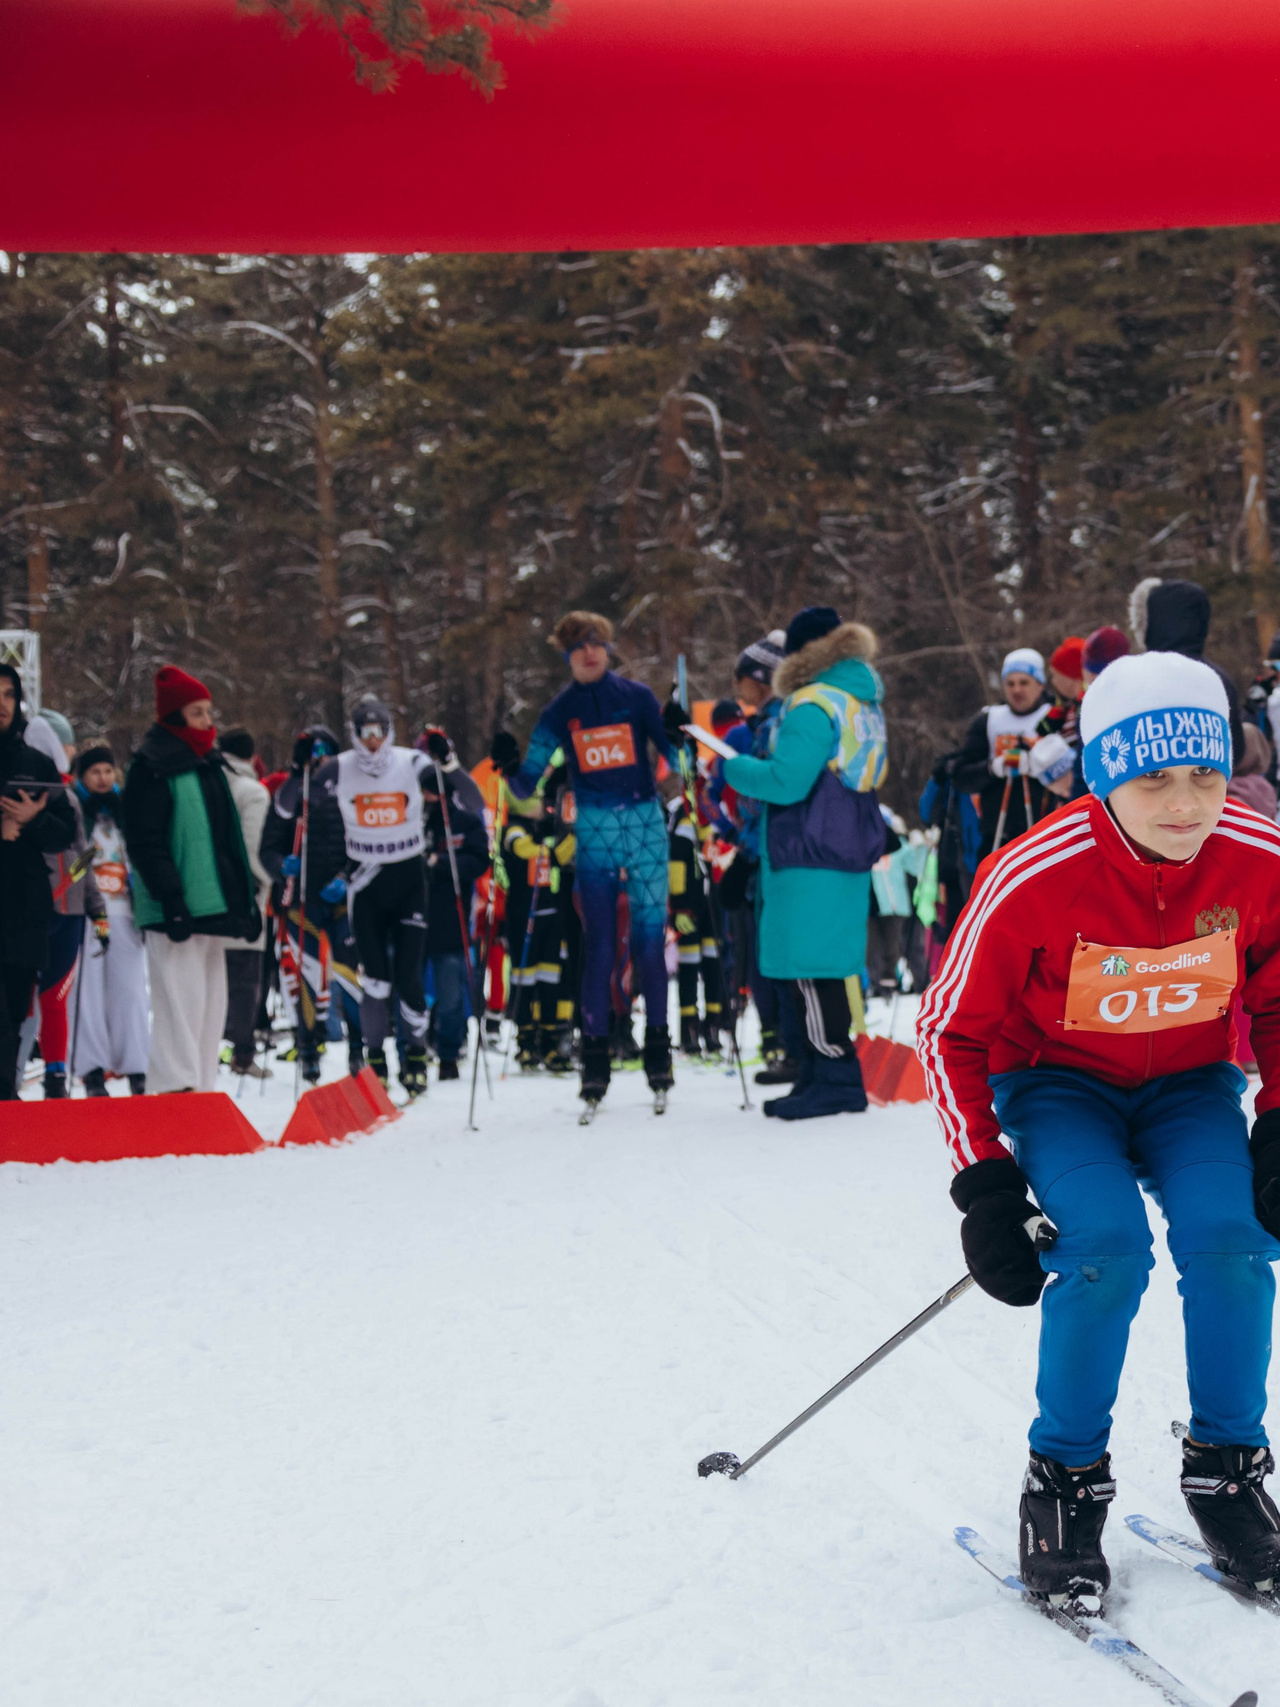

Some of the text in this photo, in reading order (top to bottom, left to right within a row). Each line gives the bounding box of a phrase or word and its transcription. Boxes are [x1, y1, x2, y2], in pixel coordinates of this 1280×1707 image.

[1134, 711, 1224, 745] ЛЫЖНЯ
[585, 743, 626, 767] 014
[1134, 736, 1225, 768] РОССИИ
[363, 807, 399, 825] 019
[1135, 951, 1212, 974] Goodline
[1098, 982, 1202, 1024] 013
